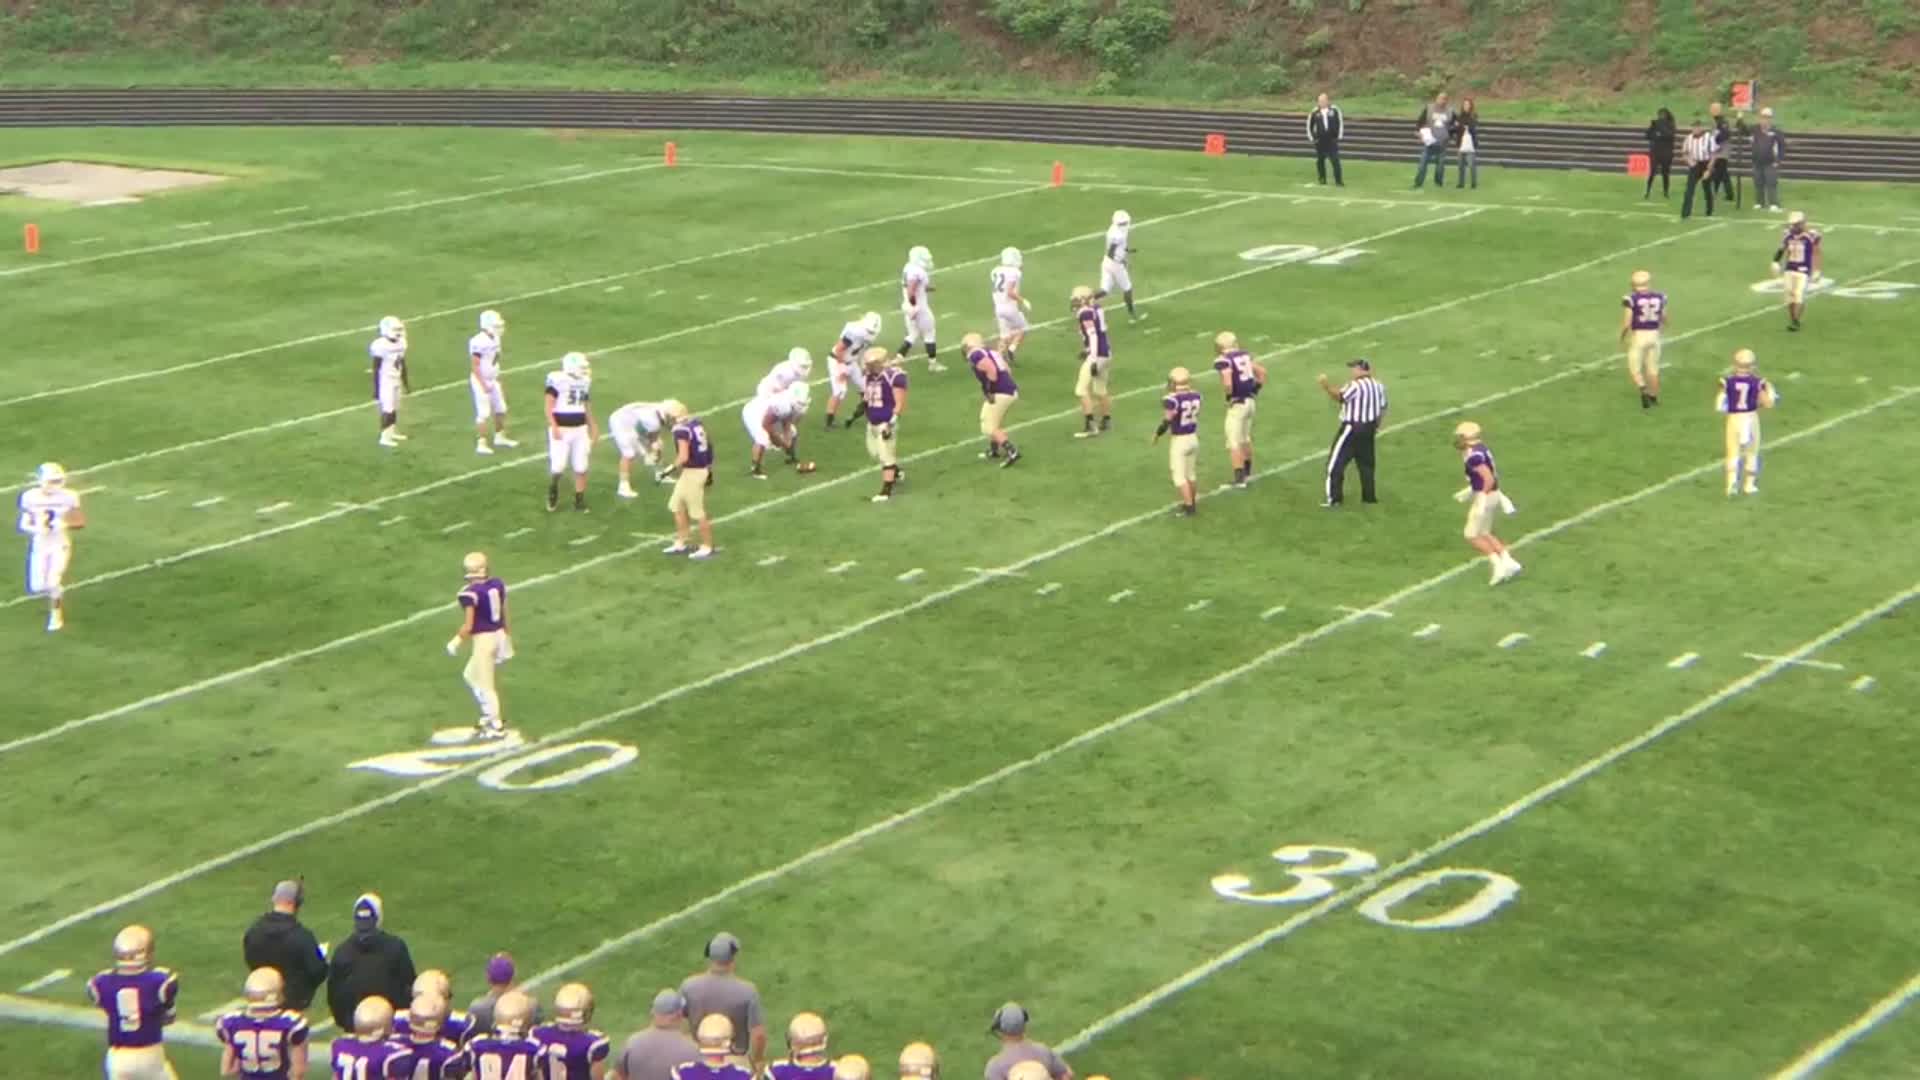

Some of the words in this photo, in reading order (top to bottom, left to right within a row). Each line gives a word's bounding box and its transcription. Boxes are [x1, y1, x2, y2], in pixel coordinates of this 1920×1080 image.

[1637, 297, 1662, 322] 32
[1735, 382, 1749, 409] 7
[346, 727, 639, 791] 20
[1211, 845, 1521, 929] 30
[234, 1030, 282, 1072] 35
